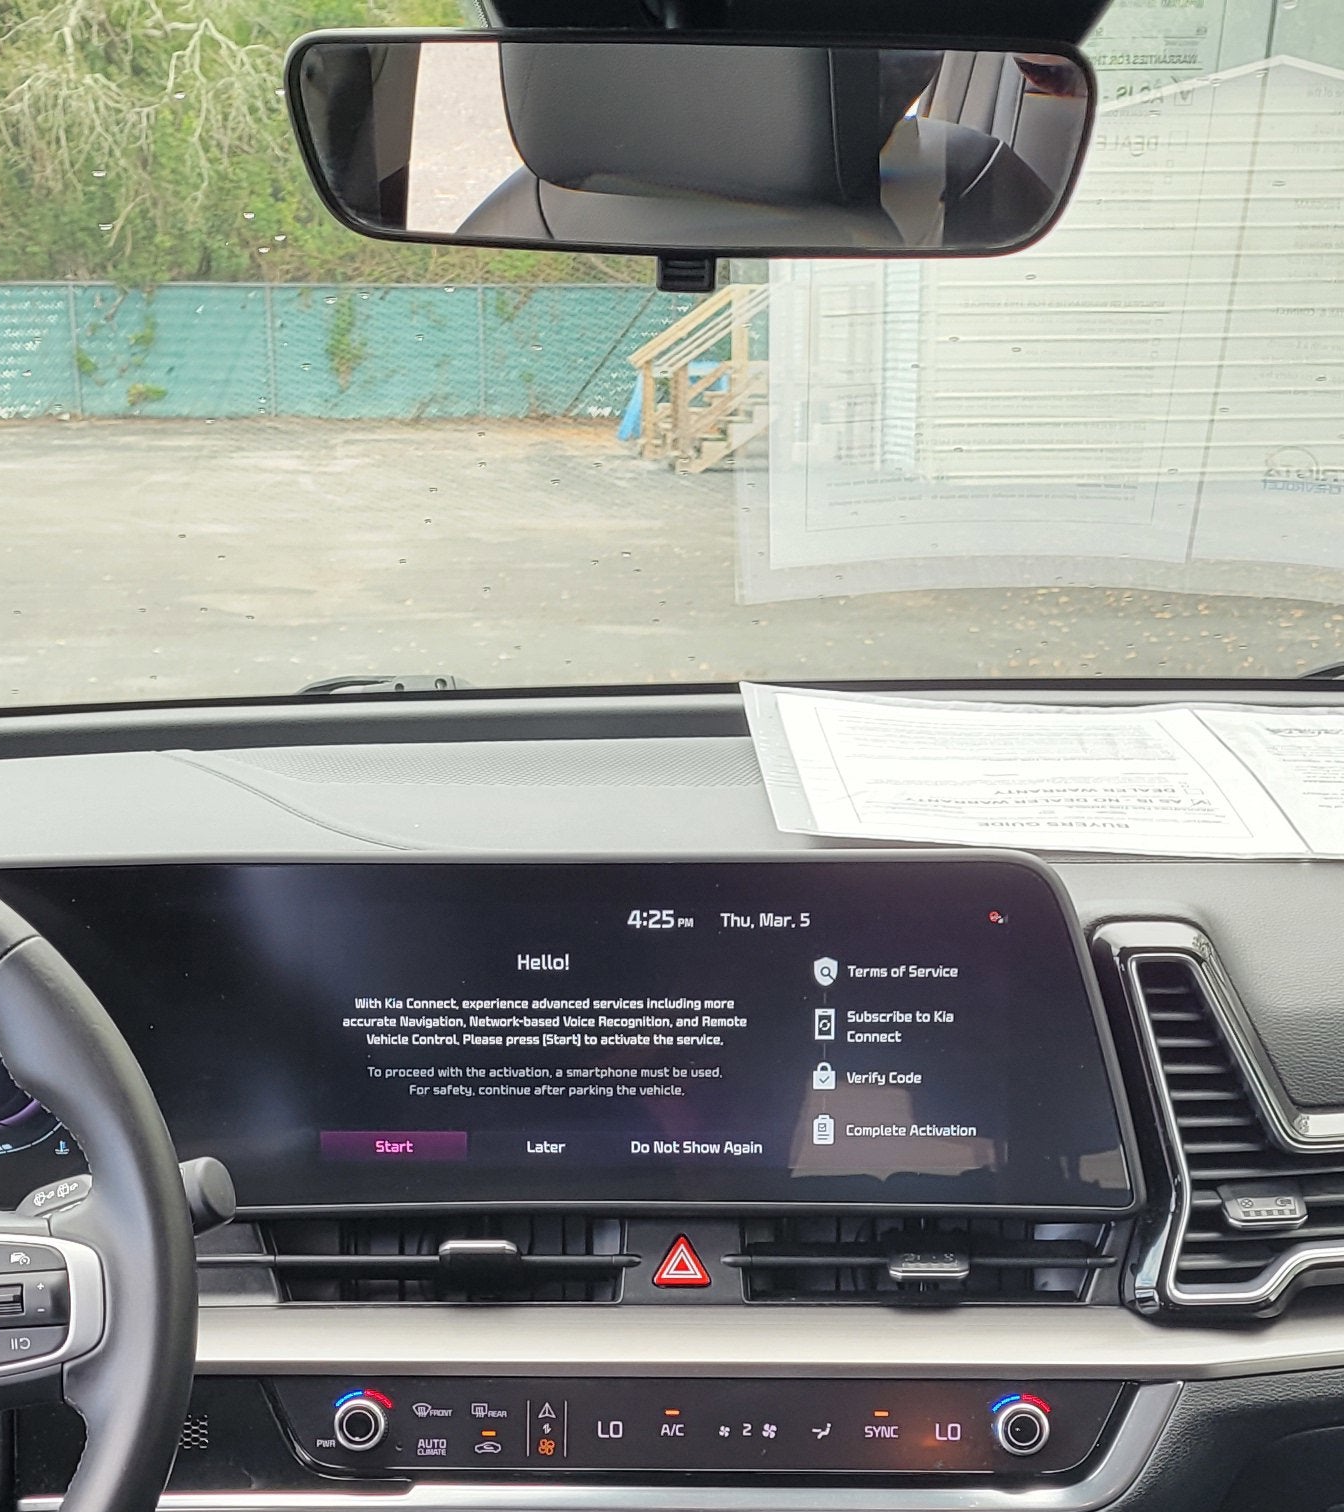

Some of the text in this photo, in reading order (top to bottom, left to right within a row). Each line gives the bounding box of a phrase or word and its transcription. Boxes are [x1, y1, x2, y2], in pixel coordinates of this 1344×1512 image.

[1046, 821, 1130, 829] BUYERS
[626, 909, 694, 929] 4:25 PM
[719, 912, 811, 929] Thu, Mar. 5
[517, 953, 570, 971] Hello!
[847, 964, 959, 978] Terms of Service
[354, 997, 735, 1011] With Kia Connect, experience advanced services including more
[342, 1015, 748, 1029] accurate Navigation, Network-based Voice Recognition, and Remote
[846, 1010, 955, 1023] Subscribe to Kia
[366, 1033, 724, 1047] Vehicle Control. Please press [Start] to activate the service.
[846, 1030, 902, 1043] Connect
[367, 1066, 723, 1080] To proceed with the activation, a smartphone must be used.
[846, 1071, 922, 1086] Verify Code
[409, 1084, 685, 1097] For safety, continue after parking the vehicle.
[845, 1124, 977, 1138] Complete Activation
[375, 1140, 414, 1153] Start
[526, 1140, 566, 1154] Later
[630, 1140, 763, 1156] Do Not Show Again
[428, 1408, 453, 1418] FRONT
[487, 1410, 508, 1419] REAR
[597, 1420, 624, 1439] LO
[660, 1423, 686, 1437] A/C
[742, 1423, 753, 1437] 2
[864, 1425, 900, 1439] SYNC
[935, 1423, 962, 1441] LO
[316, 1439, 337, 1448] PWR
[417, 1438, 447, 1449] AUTO
[416, 1448, 447, 1457] CLIMATE
